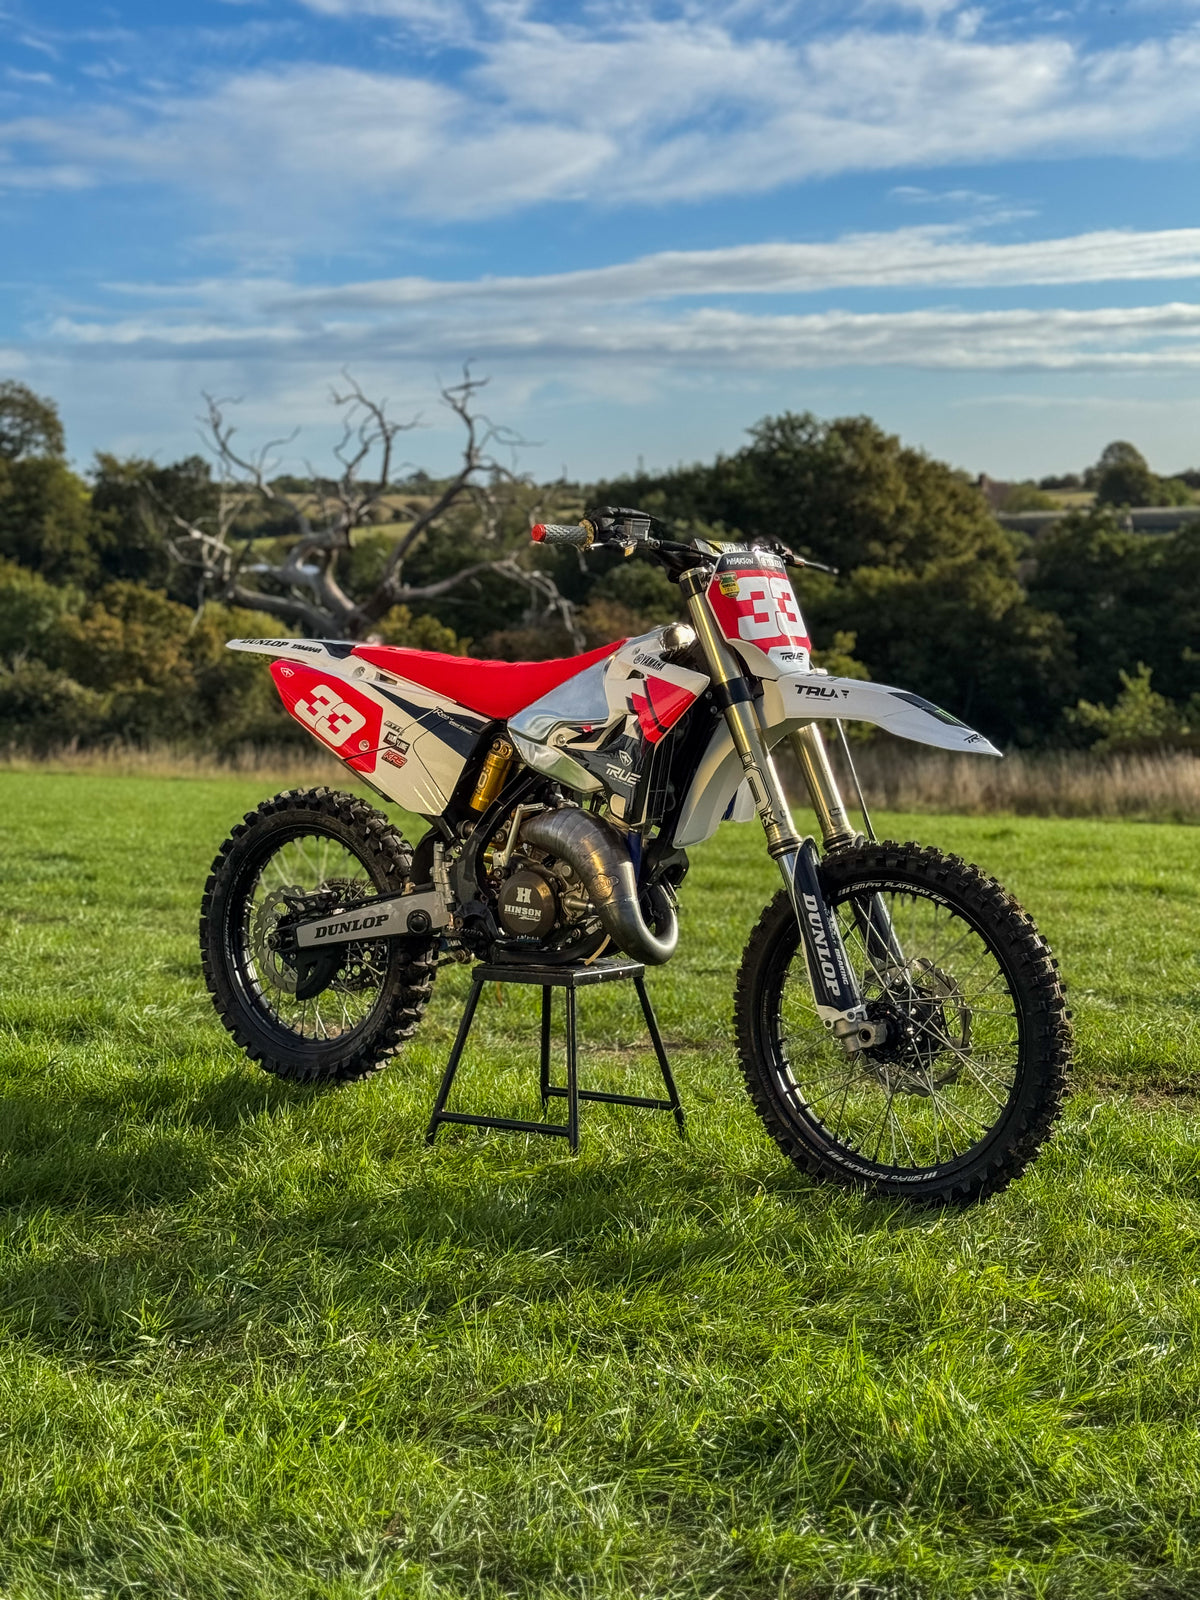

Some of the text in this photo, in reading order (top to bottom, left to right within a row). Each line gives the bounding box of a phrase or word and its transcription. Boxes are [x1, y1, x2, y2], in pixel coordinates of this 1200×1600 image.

[736, 576, 808, 640] 33
[640, 655, 667, 671] YAMAHA
[294, 684, 366, 747] 33
[606, 763, 642, 785] TRUE
[884, 881, 930, 896] PLATINUM
[504, 904, 542, 917] HINSON
[314, 914, 390, 939] DUNLOP
[803, 893, 841, 996] DUNLOP
